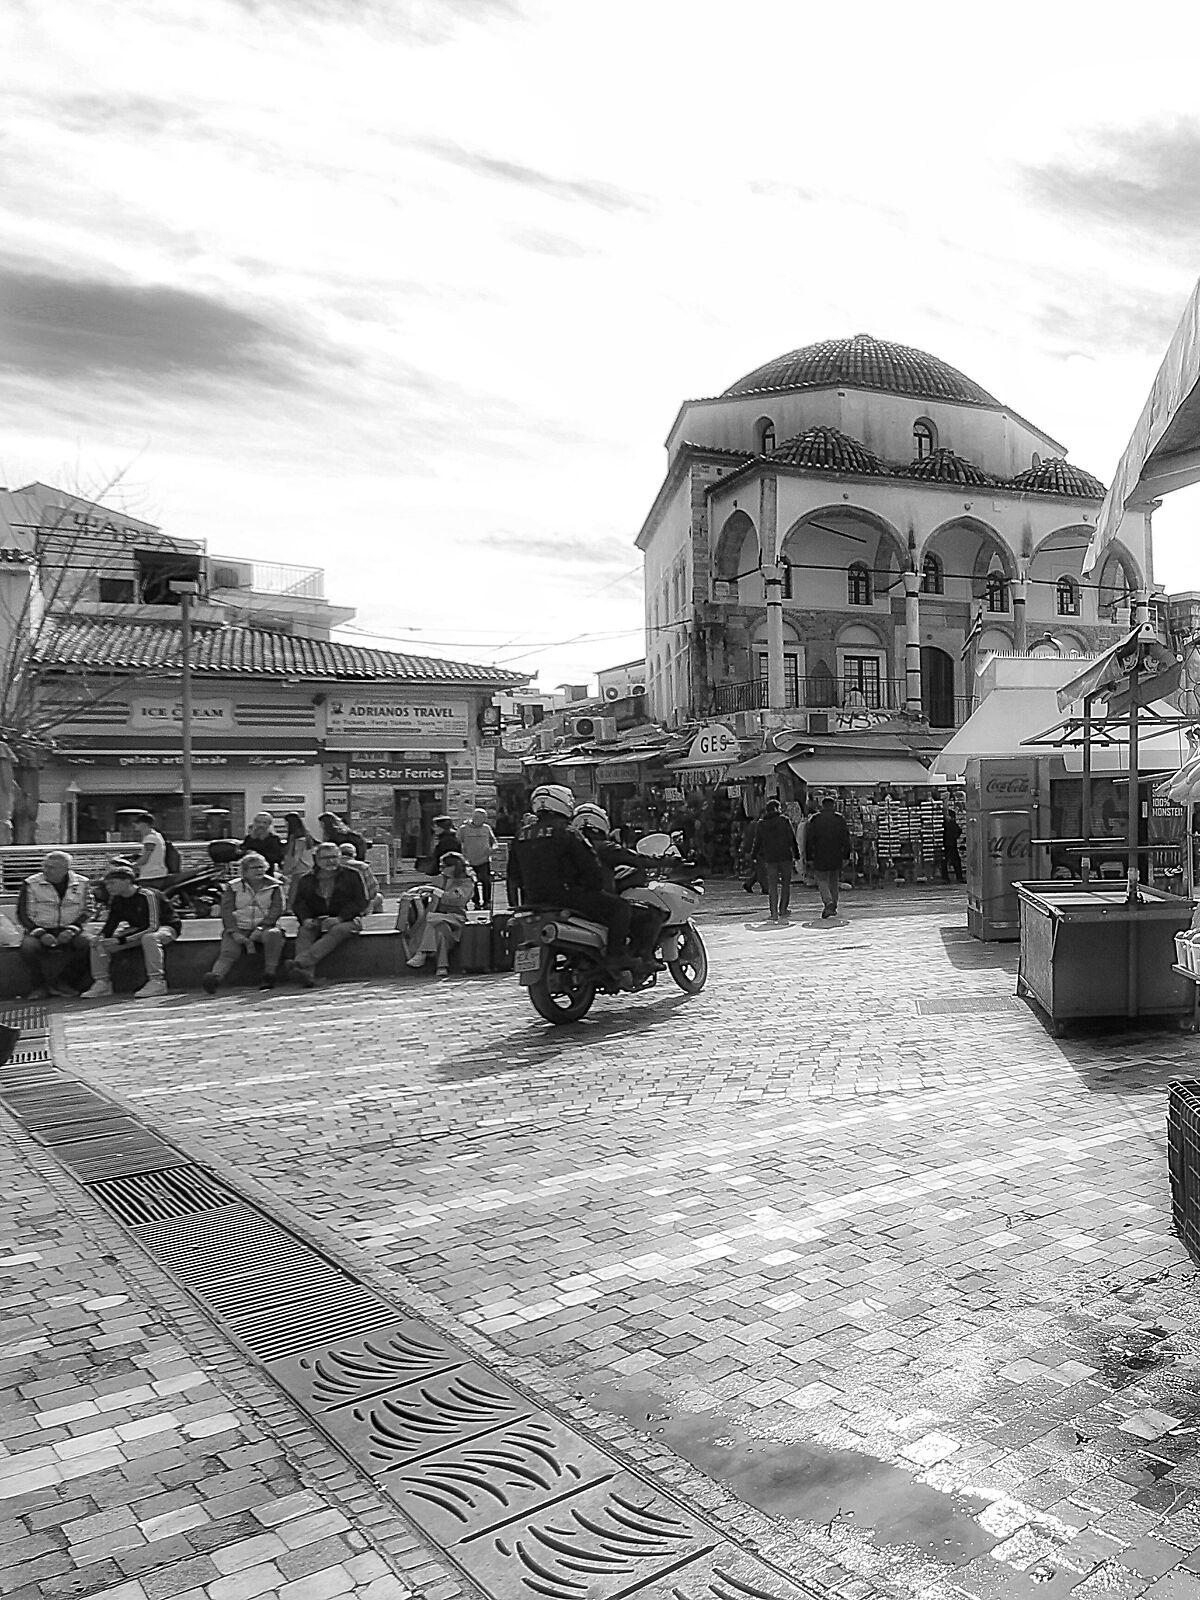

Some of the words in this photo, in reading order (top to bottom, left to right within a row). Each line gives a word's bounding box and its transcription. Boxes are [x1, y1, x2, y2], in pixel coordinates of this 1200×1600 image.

[142, 707, 167, 717] ICE
[171, 707, 224, 718] CEAM
[349, 706, 409, 717] ADRIANOS
[413, 707, 454, 718] TRAVEL
[119, 755, 160, 766] gelato
[162, 755, 228, 764] artiianale
[349, 768, 376, 779] Blue
[378, 768, 403, 779] Star
[405, 768, 445, 779] Ferries
[1152, 798, 1171, 807] 100%
